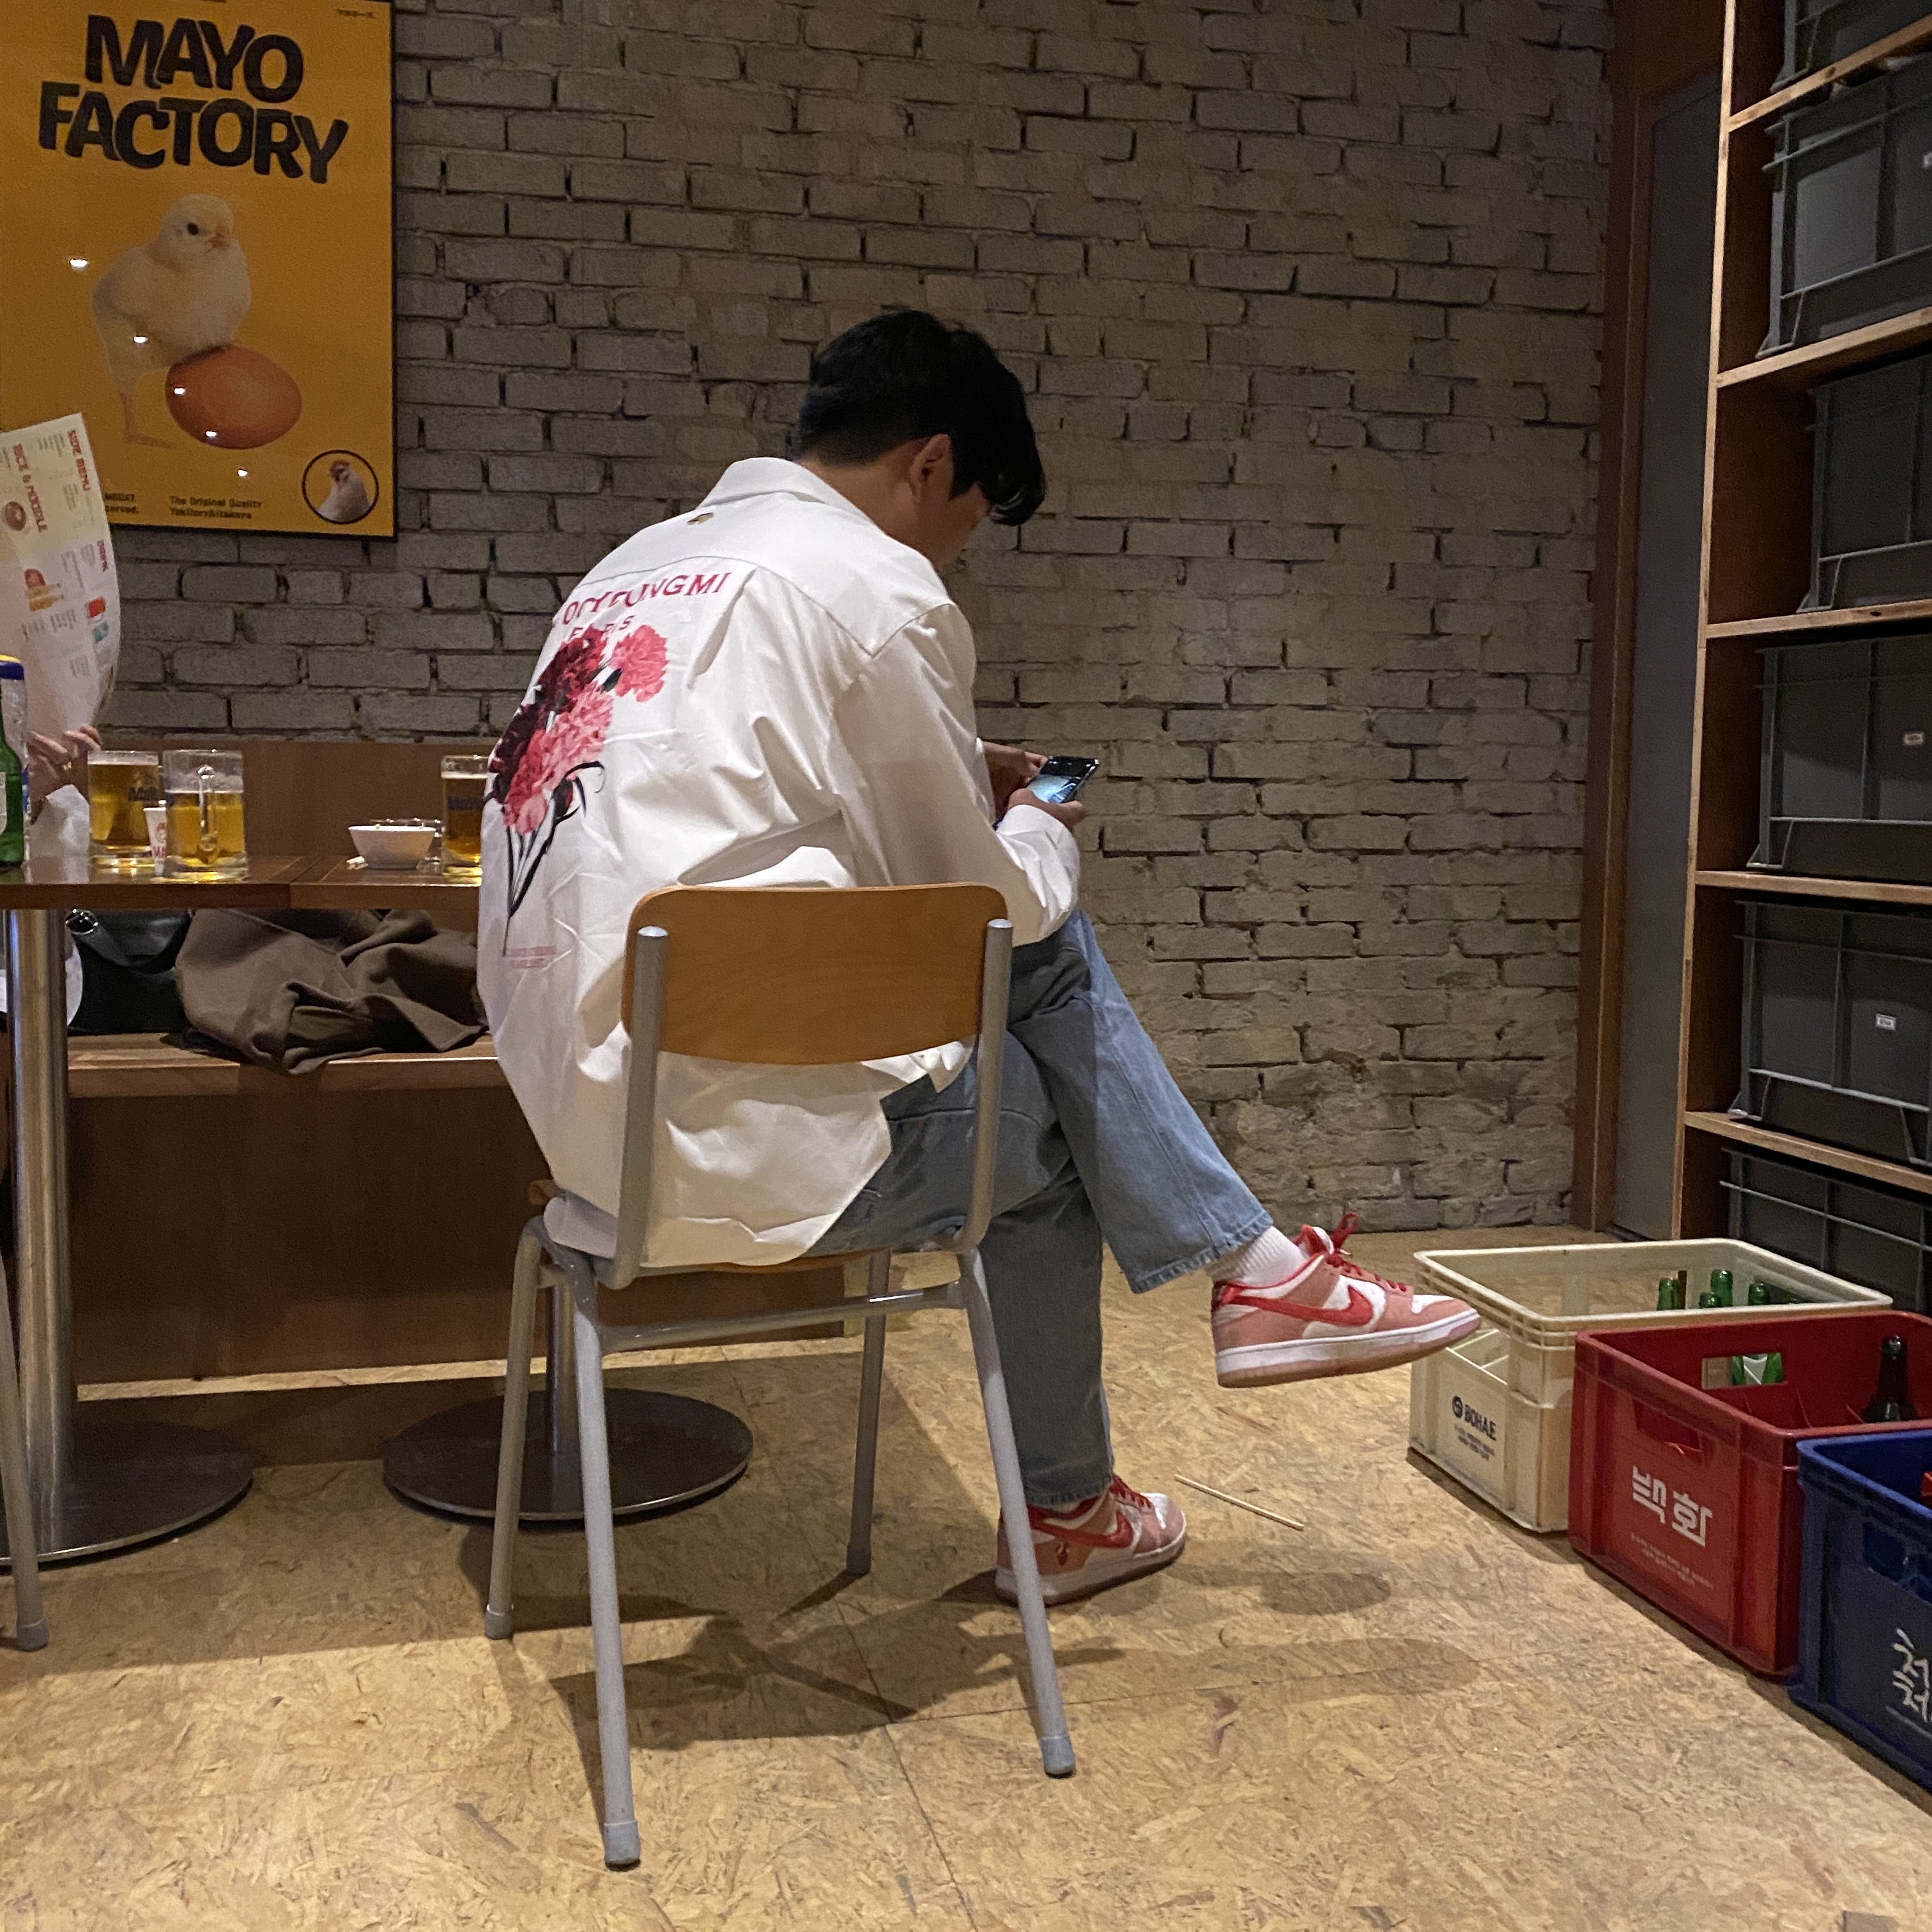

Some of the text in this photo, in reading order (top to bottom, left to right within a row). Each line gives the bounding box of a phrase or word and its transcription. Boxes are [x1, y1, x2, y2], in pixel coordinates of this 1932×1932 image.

[85, 14, 304, 103] MAYO
[38, 80, 349, 184] FACTORY
[169, 495, 263, 509] The Original Quality
[1464, 1404, 1496, 1441] BOHAE
